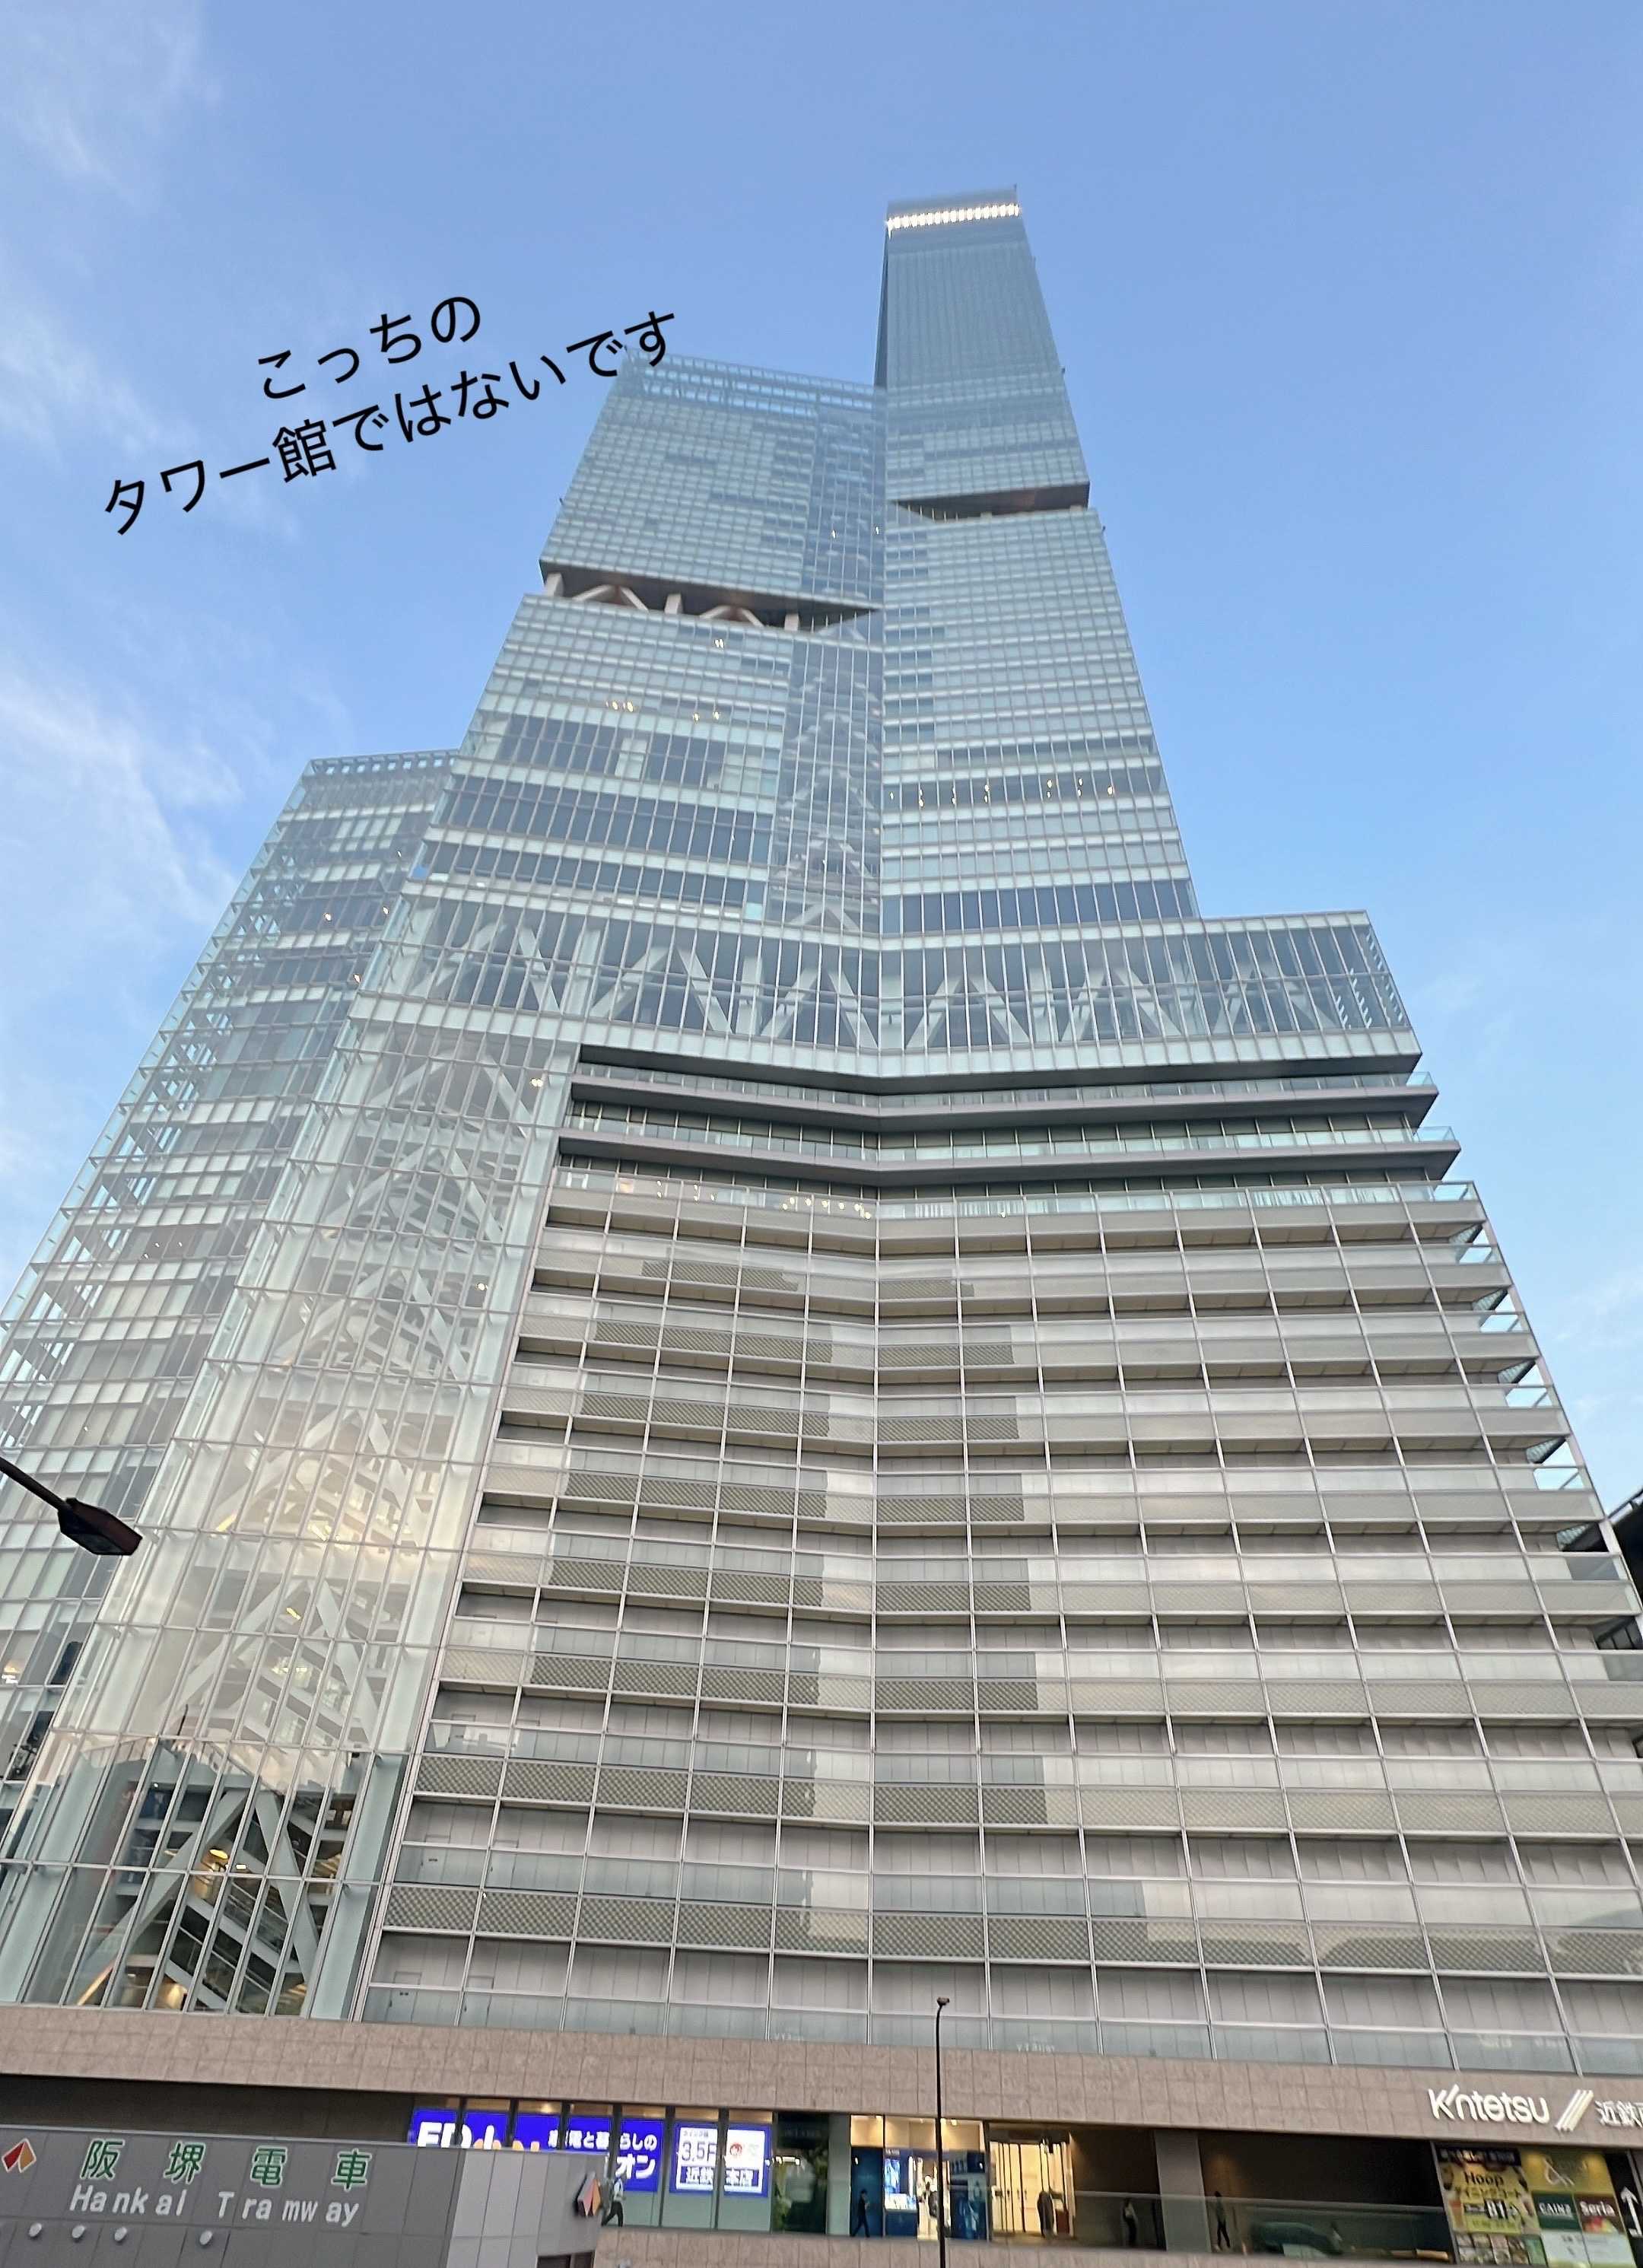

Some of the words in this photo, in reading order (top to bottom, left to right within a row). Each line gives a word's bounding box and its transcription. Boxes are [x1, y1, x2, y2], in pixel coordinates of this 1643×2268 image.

[1428, 2084, 1549, 2124] Kintetsu
[79, 2138, 373, 2191] 阪堺電車
[1464, 2171, 1504, 2187] Hoop
[69, 2184, 186, 2217] Hankai
[218, 2191, 359, 2227] Tramway
[1579, 2200, 1616, 2217] Seria
